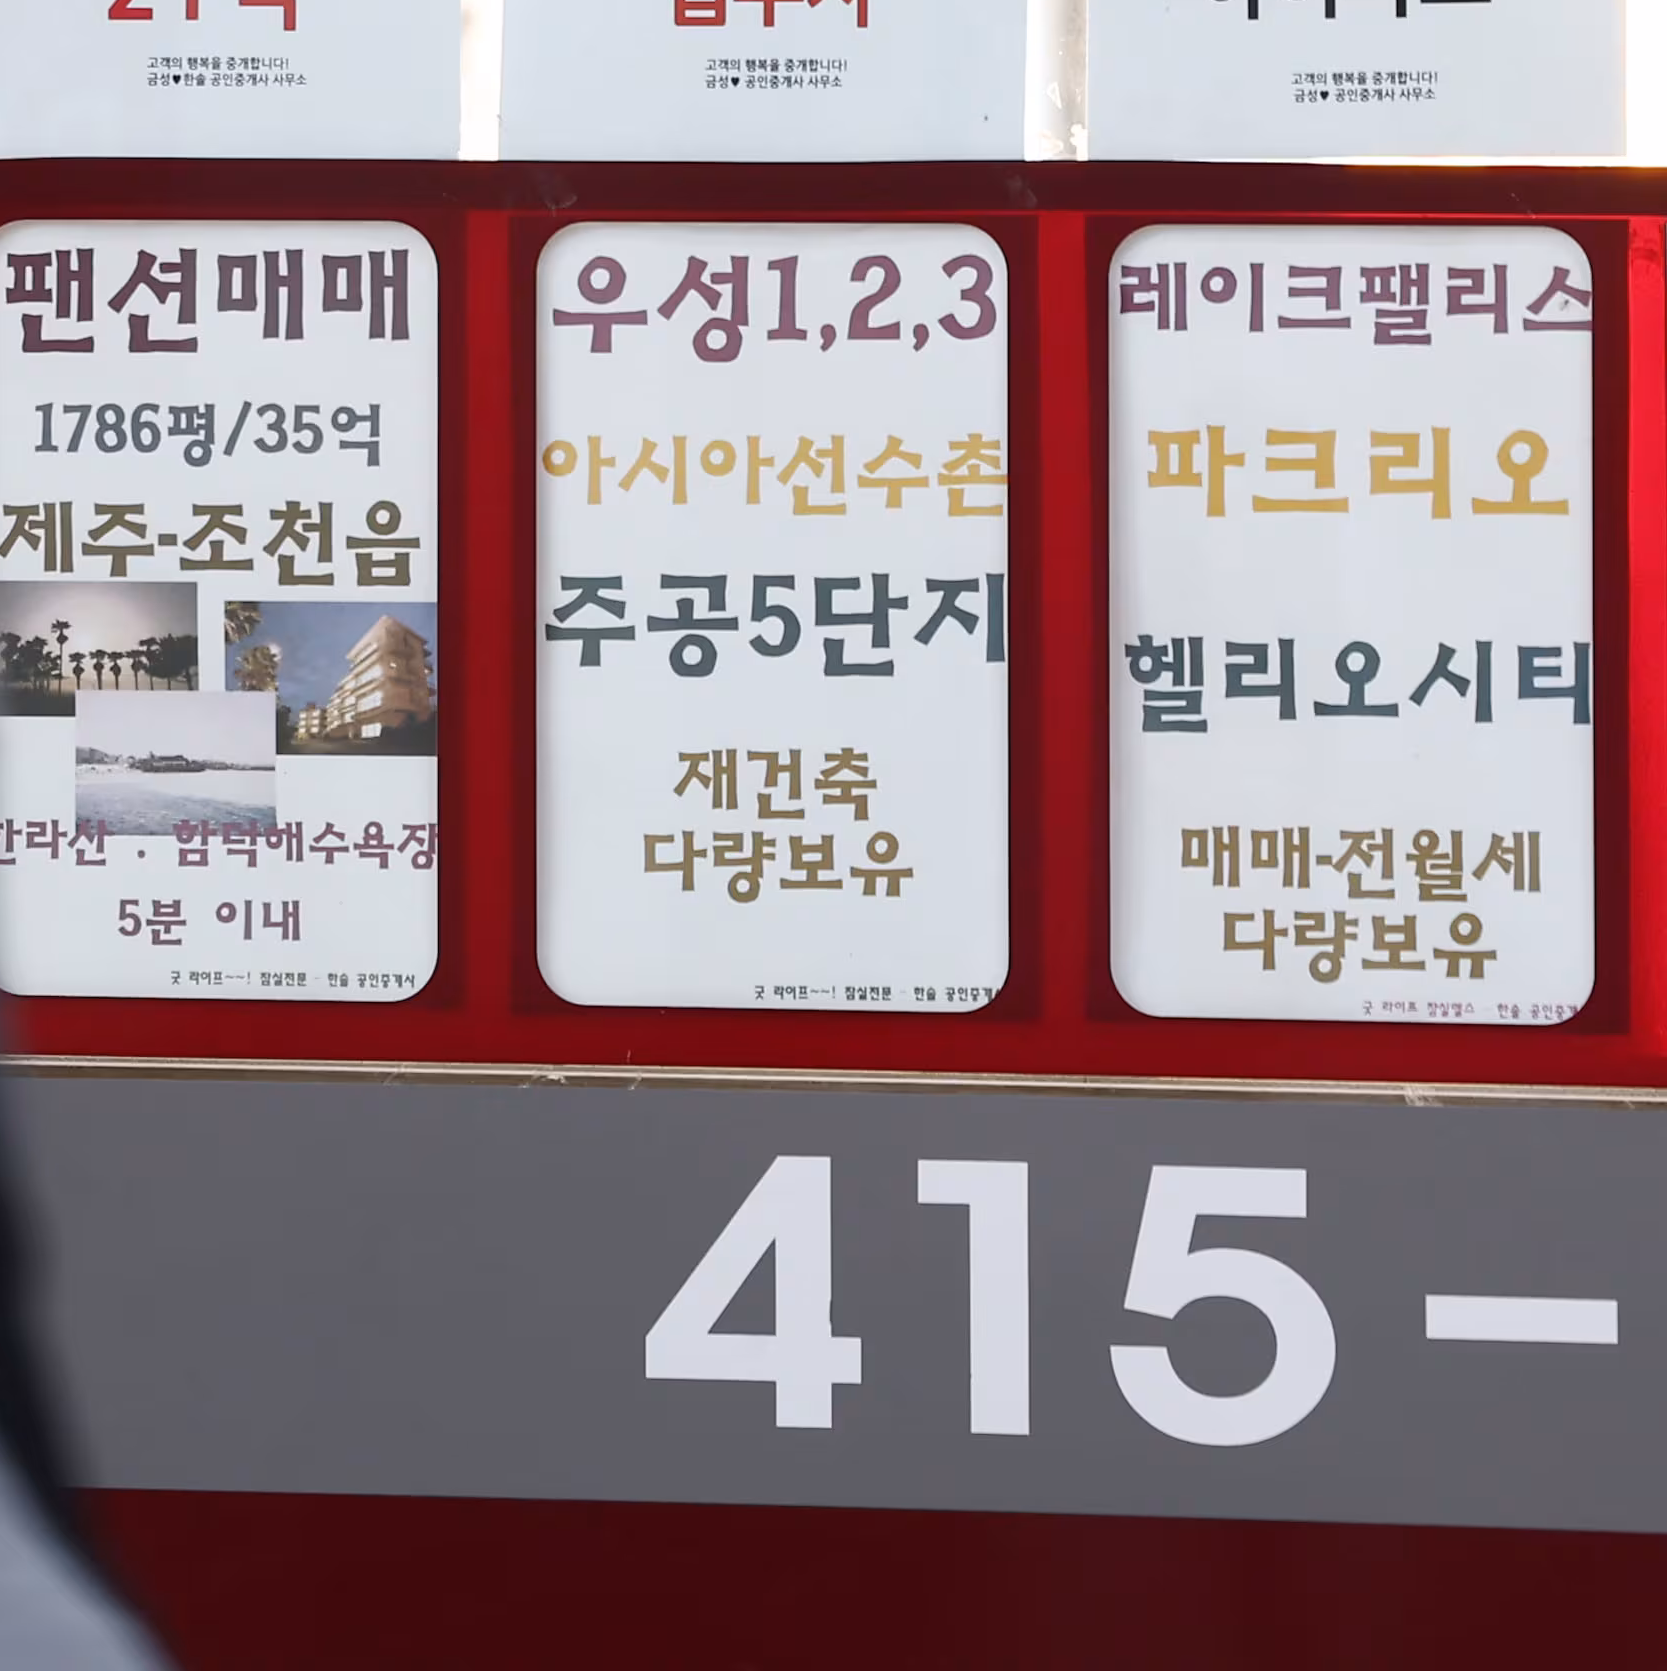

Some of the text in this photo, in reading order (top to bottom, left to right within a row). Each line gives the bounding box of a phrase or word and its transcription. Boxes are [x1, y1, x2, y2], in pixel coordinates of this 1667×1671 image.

[147, 57, 289, 70] 고객의 행복을 중개합니다!
[1291, 71, 1438, 86] 고객의 행복을 중개합니다!
[6, 248, 409, 353] 팬션매매
[553, 254, 996, 362] 우성1,2,3
[1117, 260, 1593, 348] 레이크팰리스
[35, 401, 380, 467] 1786평/35억
[1147, 425, 1569, 519] 파크리오
[539, 431, 1006, 519] 아시아선수촌
[542, 571, 1006, 681] 주공5단지
[1122, 631, 1592, 735] 헬리오시티
[674, 748, 877, 821] 재건축
[644, 831, 913, 903] 다량보유
[1182, 825, 1540, 902] 매매-전월세
[119, 899, 300, 945] 5분 이내
[1224, 909, 1497, 983] 다량보유
[260, 972, 307, 986] 잠실전문
[327, 973, 349, 987] 한솔
[646, 1156, 1618, 1446] 415-
